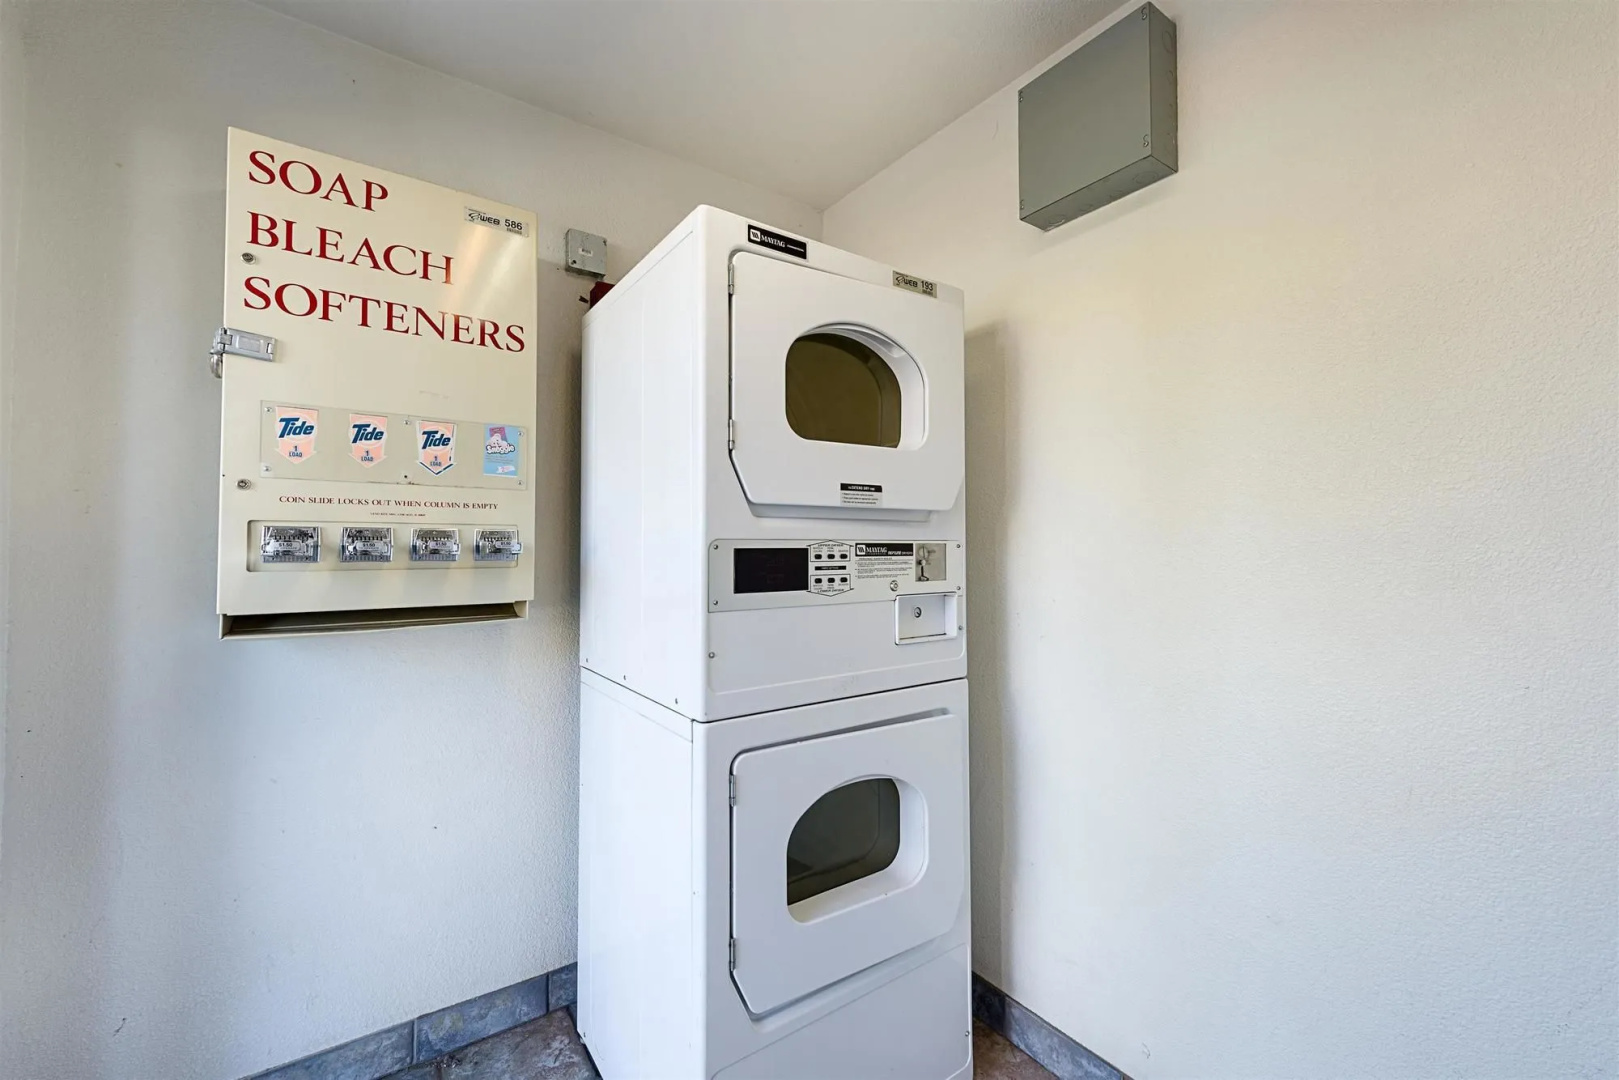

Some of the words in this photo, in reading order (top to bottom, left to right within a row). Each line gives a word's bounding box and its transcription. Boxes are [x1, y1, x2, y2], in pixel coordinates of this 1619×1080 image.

[248, 150, 388, 212] SOAP
[480, 214, 501, 226] WEB
[504, 218, 523, 231] 586
[246, 210, 455, 286] BLEACH
[761, 234, 786, 248] MAYTAG
[903, 278, 918, 288] WEB
[921, 280, 934, 291] 193
[243, 275, 526, 353] SOFTENERS
[278, 417, 315, 438] Tide
[351, 423, 385, 444] Tide
[421, 430, 452, 450] Tide
[279, 495, 306, 503] COIN
[308, 496, 335, 505] SLIDE
[338, 498, 369, 506] LOCKS
[424, 500, 461, 508] COLUMN
